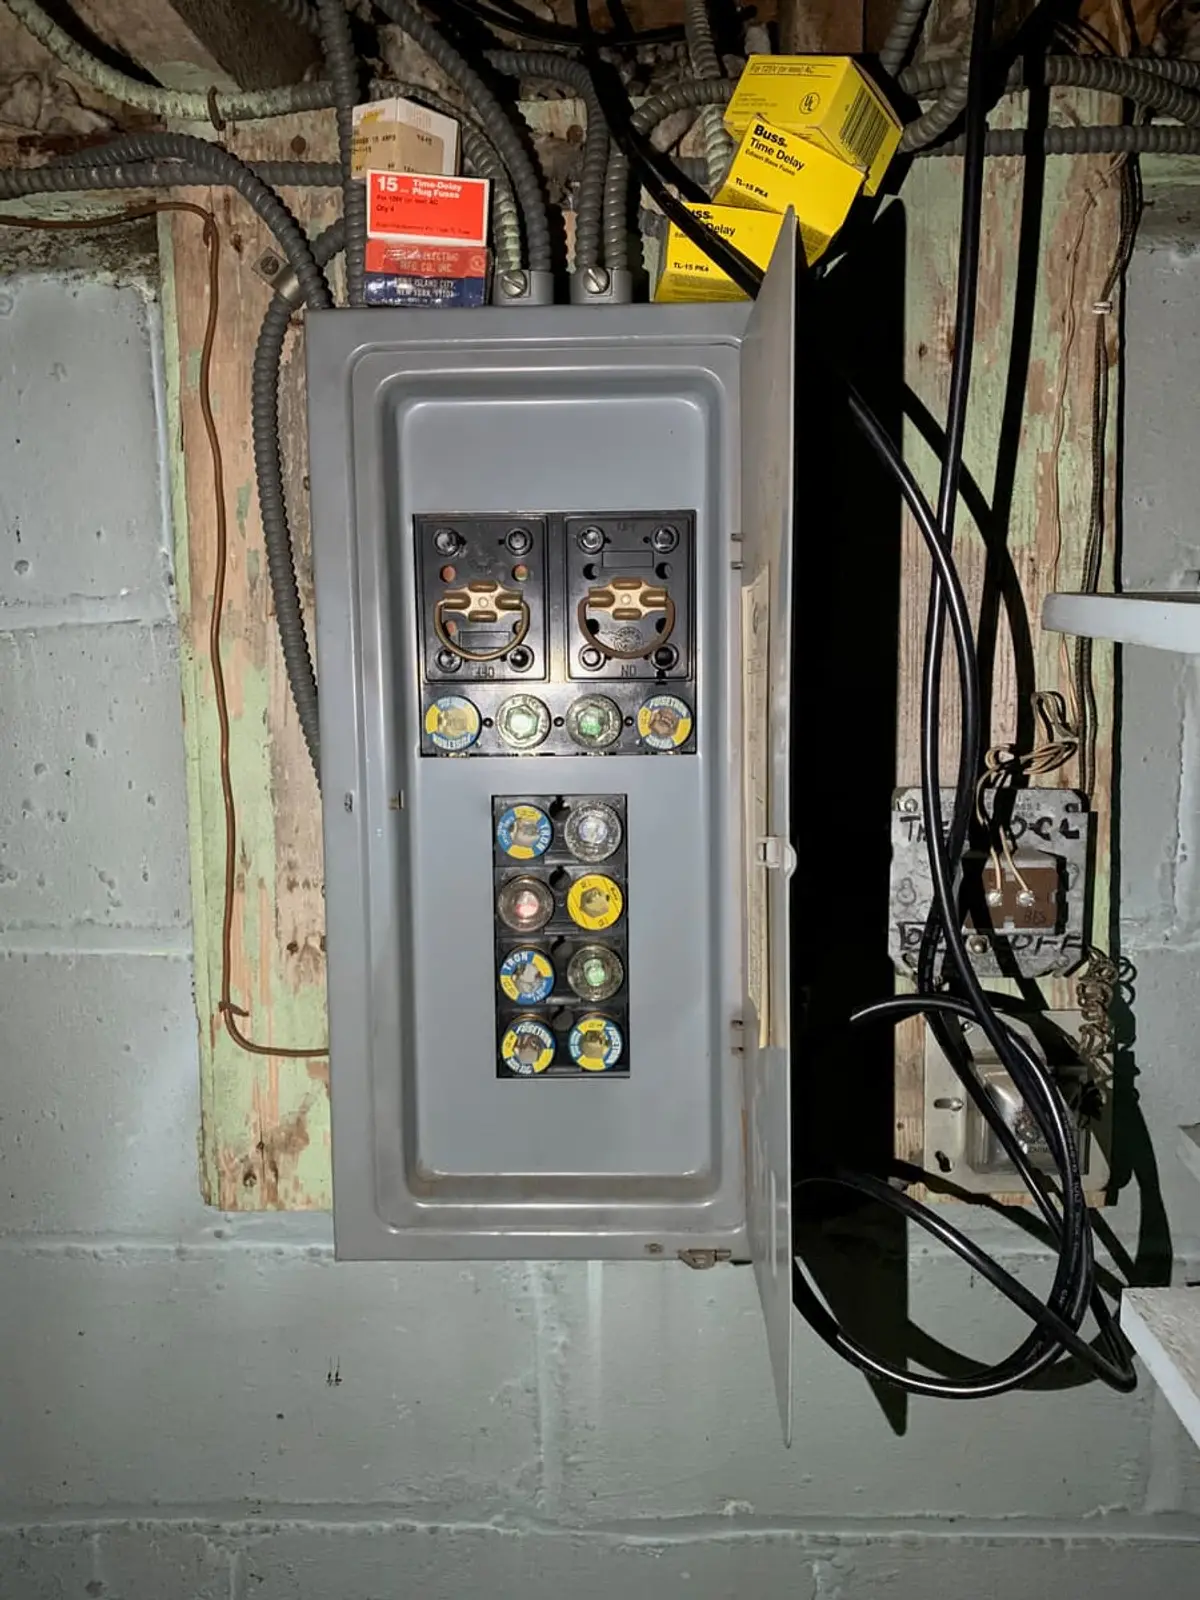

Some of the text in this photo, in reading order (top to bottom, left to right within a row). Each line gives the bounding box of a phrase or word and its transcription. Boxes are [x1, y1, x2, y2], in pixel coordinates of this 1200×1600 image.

[750, 137, 805, 171] Time Delay
[377, 176, 463, 192] 15 Time-Delay
[736, 177, 754, 191] TL-15
[412, 187, 432, 198] Plug
[434, 189, 460, 199] Fuses
